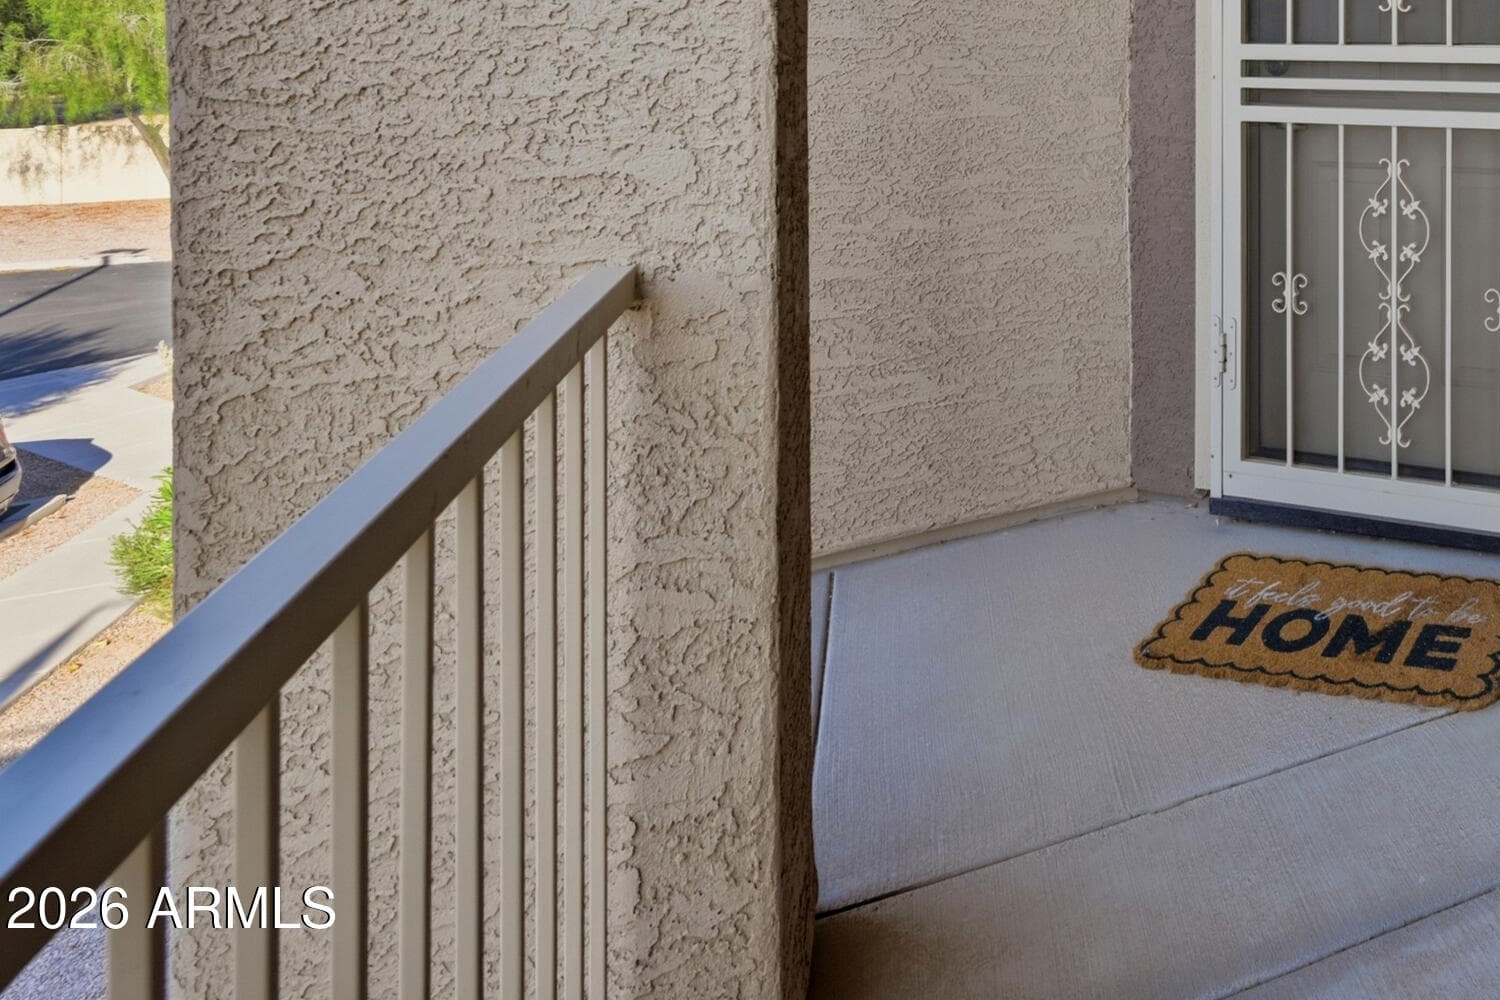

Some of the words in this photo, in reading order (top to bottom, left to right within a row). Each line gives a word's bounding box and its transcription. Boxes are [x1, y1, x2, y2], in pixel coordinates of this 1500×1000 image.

[1313, 590, 1414, 621] good
[1407, 595, 1440, 621] to
[1190, 600, 1473, 672] HOME
